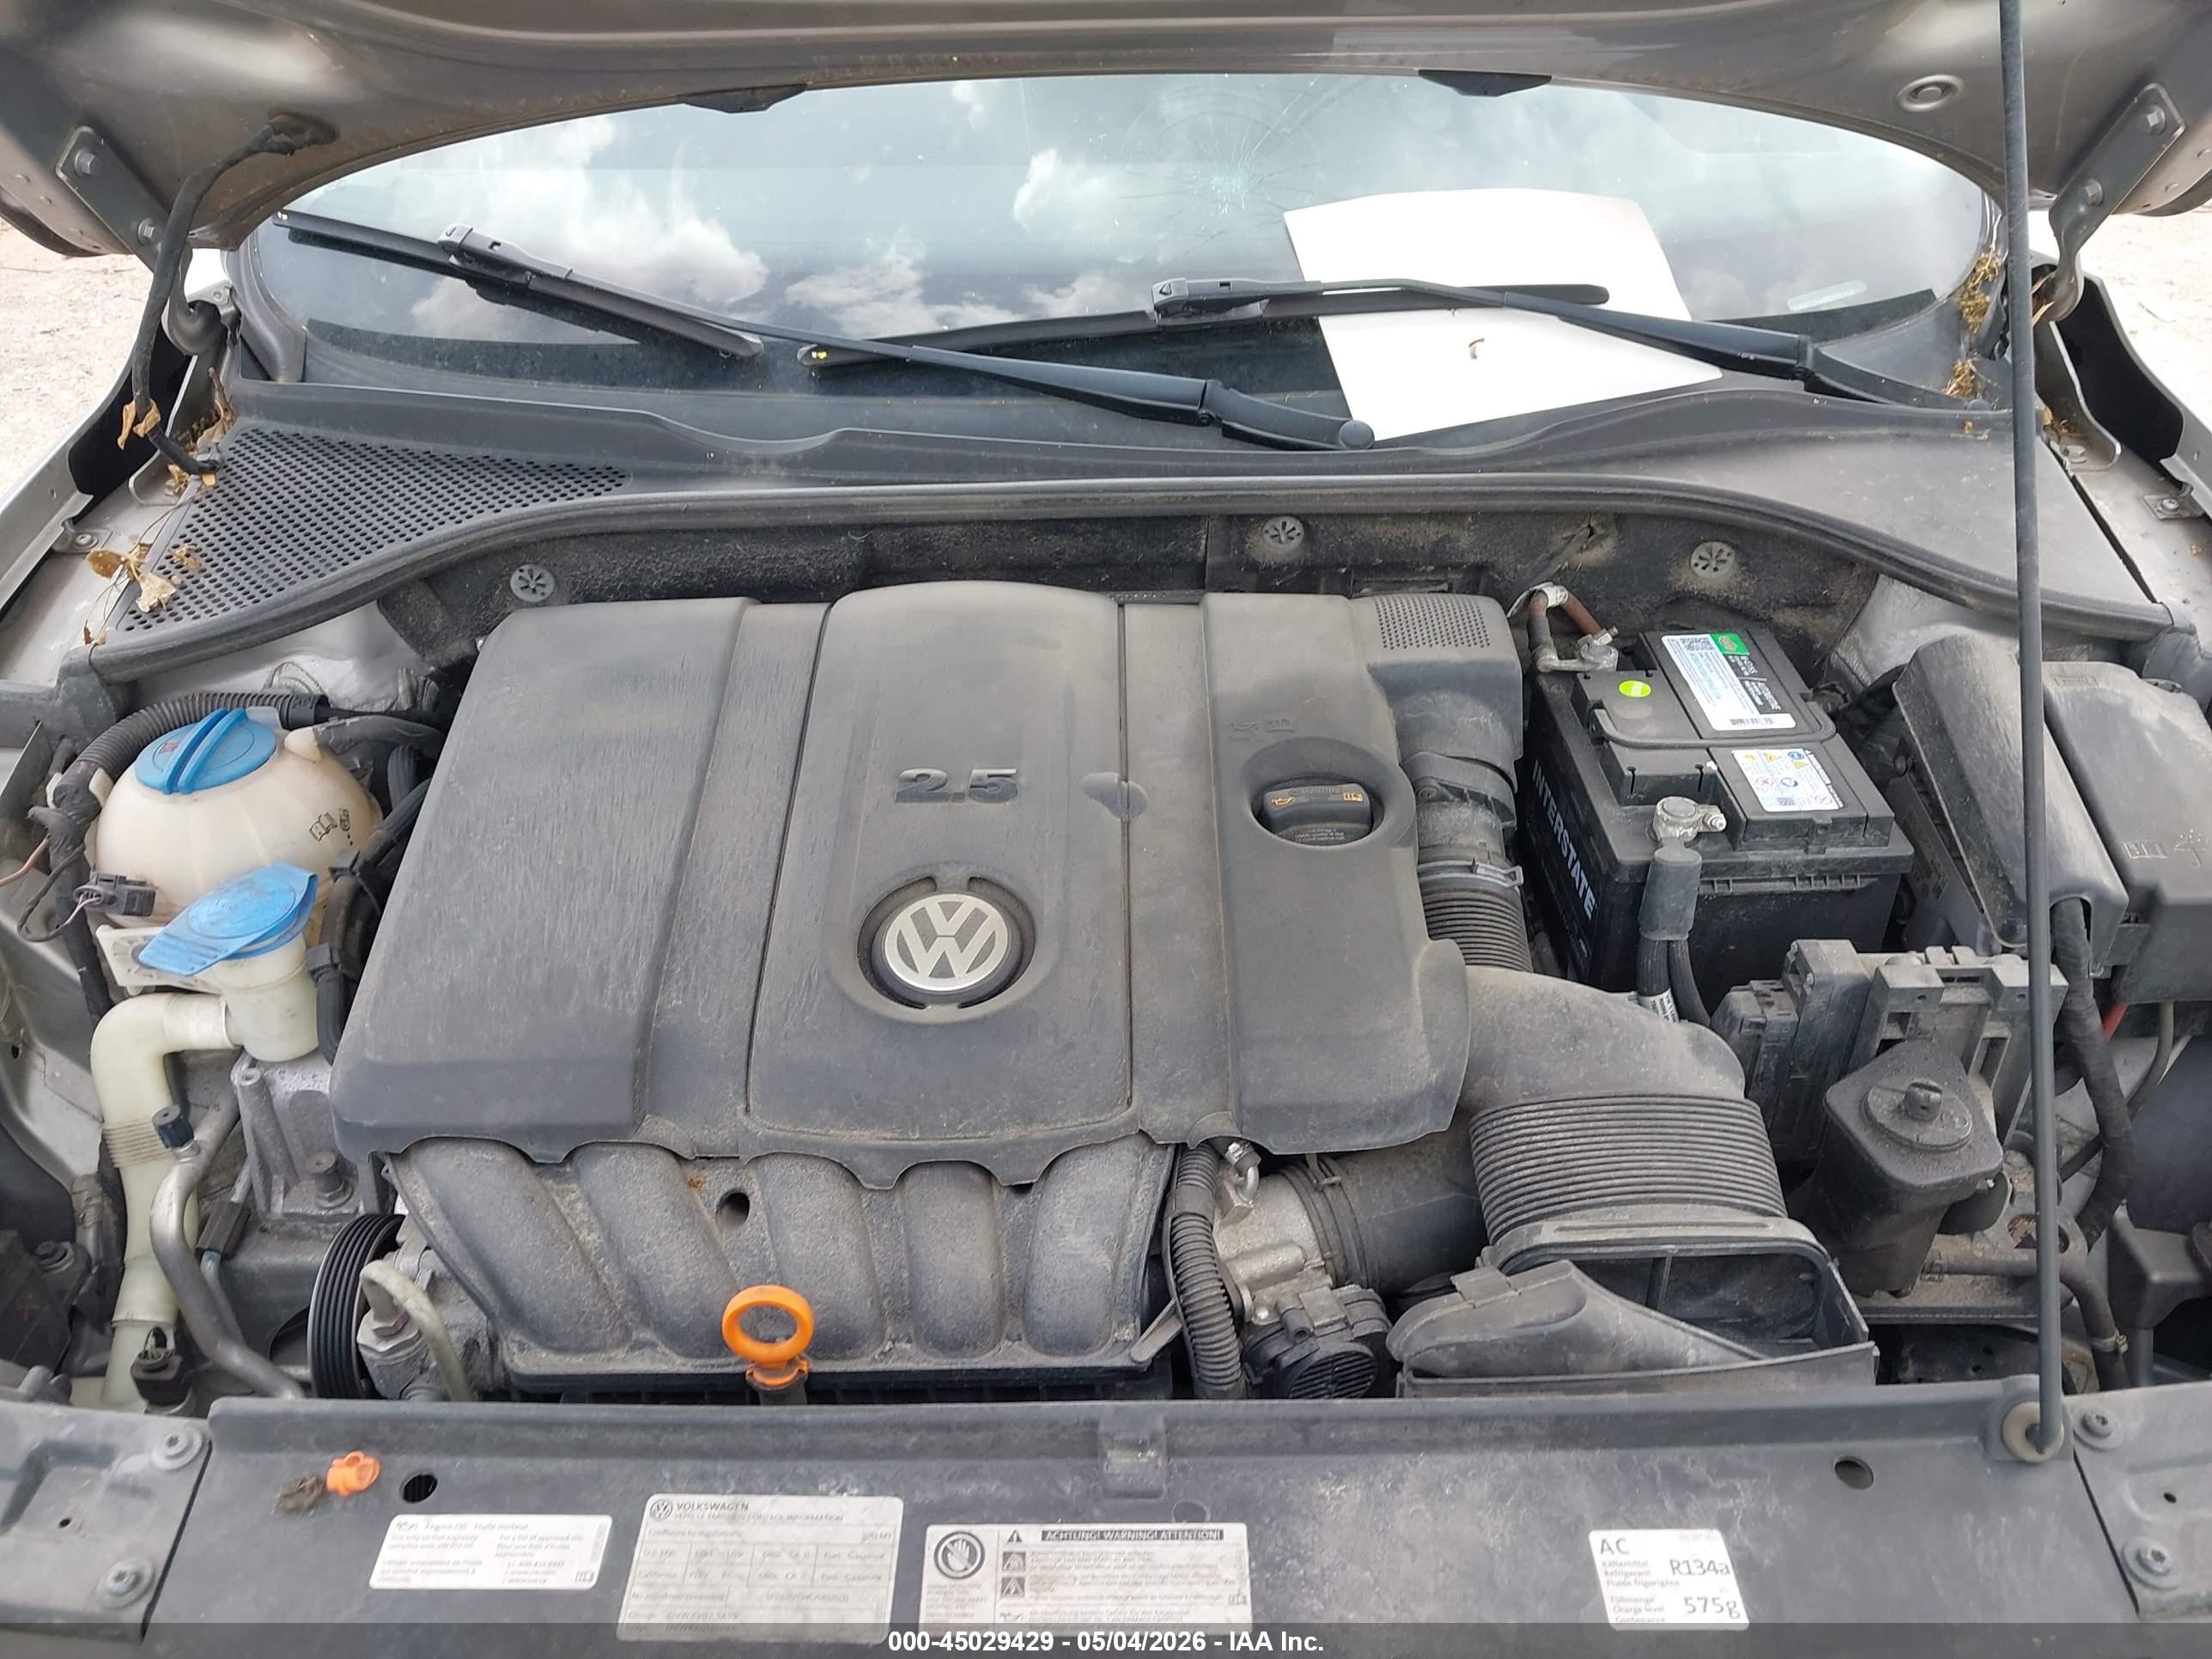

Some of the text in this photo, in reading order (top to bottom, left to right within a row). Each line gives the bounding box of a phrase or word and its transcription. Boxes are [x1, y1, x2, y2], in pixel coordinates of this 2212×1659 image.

[895, 768, 1018, 804] 2.5
[1532, 758, 1595, 921] INTERSTATE
[676, 1501, 750, 1512] VOLKSWAGEN
[1600, 1538, 1630, 1555] AC
[1668, 1559, 1731, 1576] R134a
[1683, 1596, 1741, 1620] 575g
